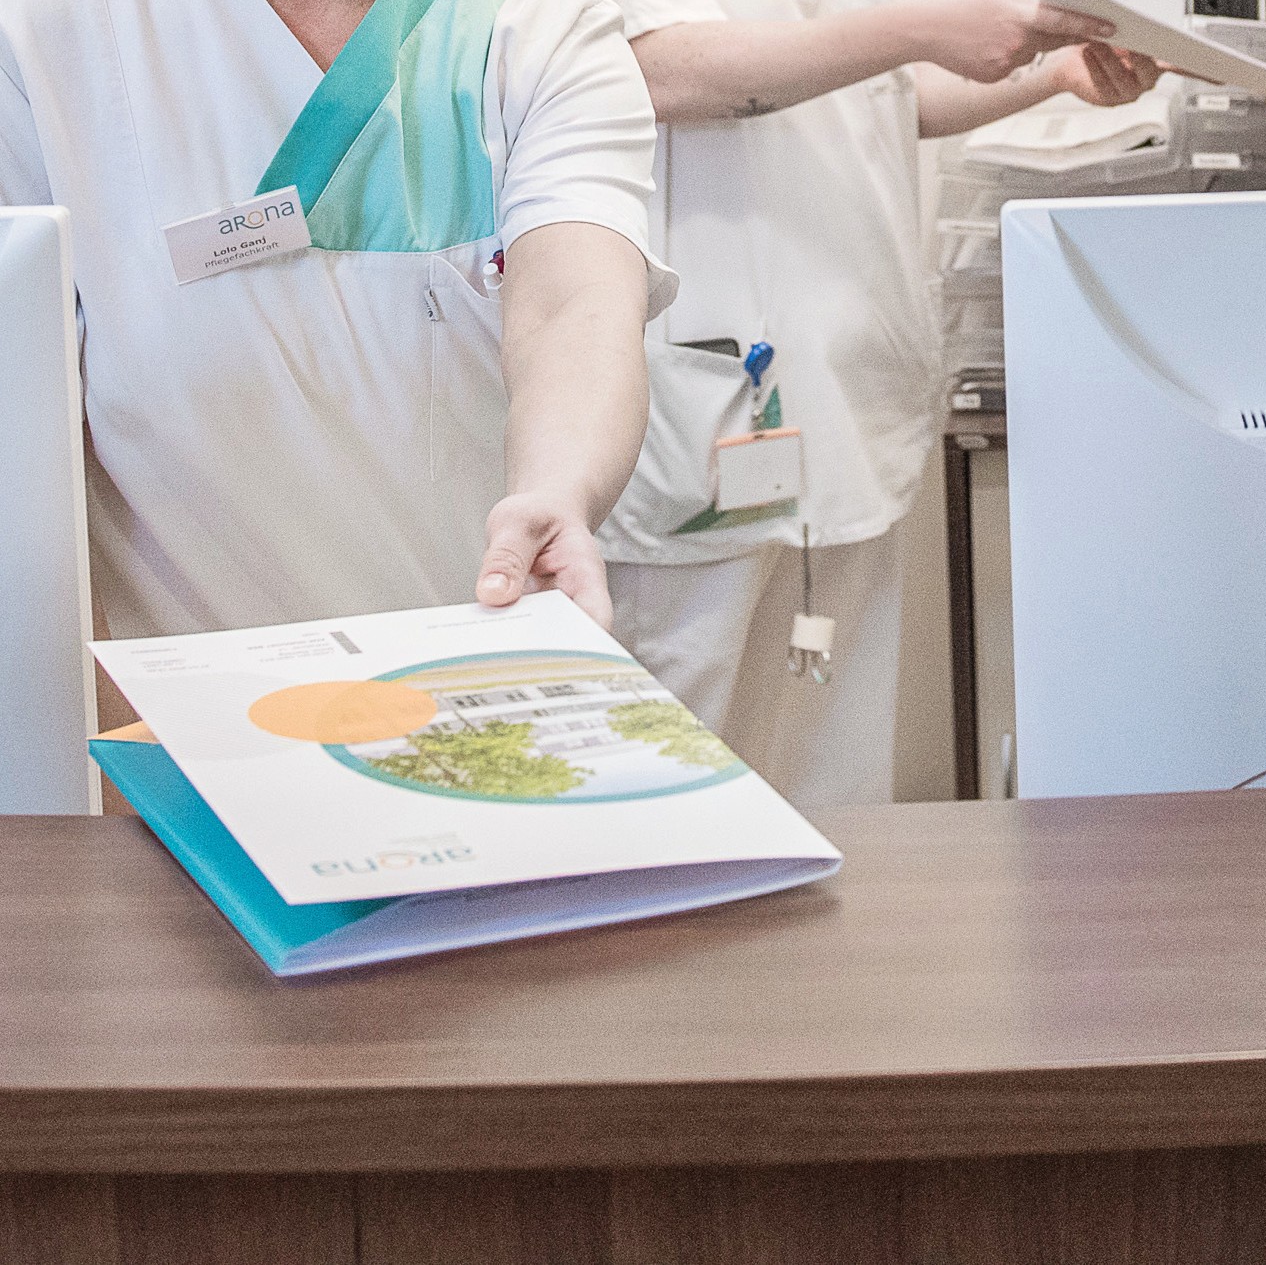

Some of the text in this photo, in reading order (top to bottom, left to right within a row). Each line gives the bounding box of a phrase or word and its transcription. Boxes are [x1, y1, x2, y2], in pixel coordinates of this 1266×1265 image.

[204, 241, 280, 268] Pflegefachkraft
[213, 236, 267, 257] Lolo Ganj
